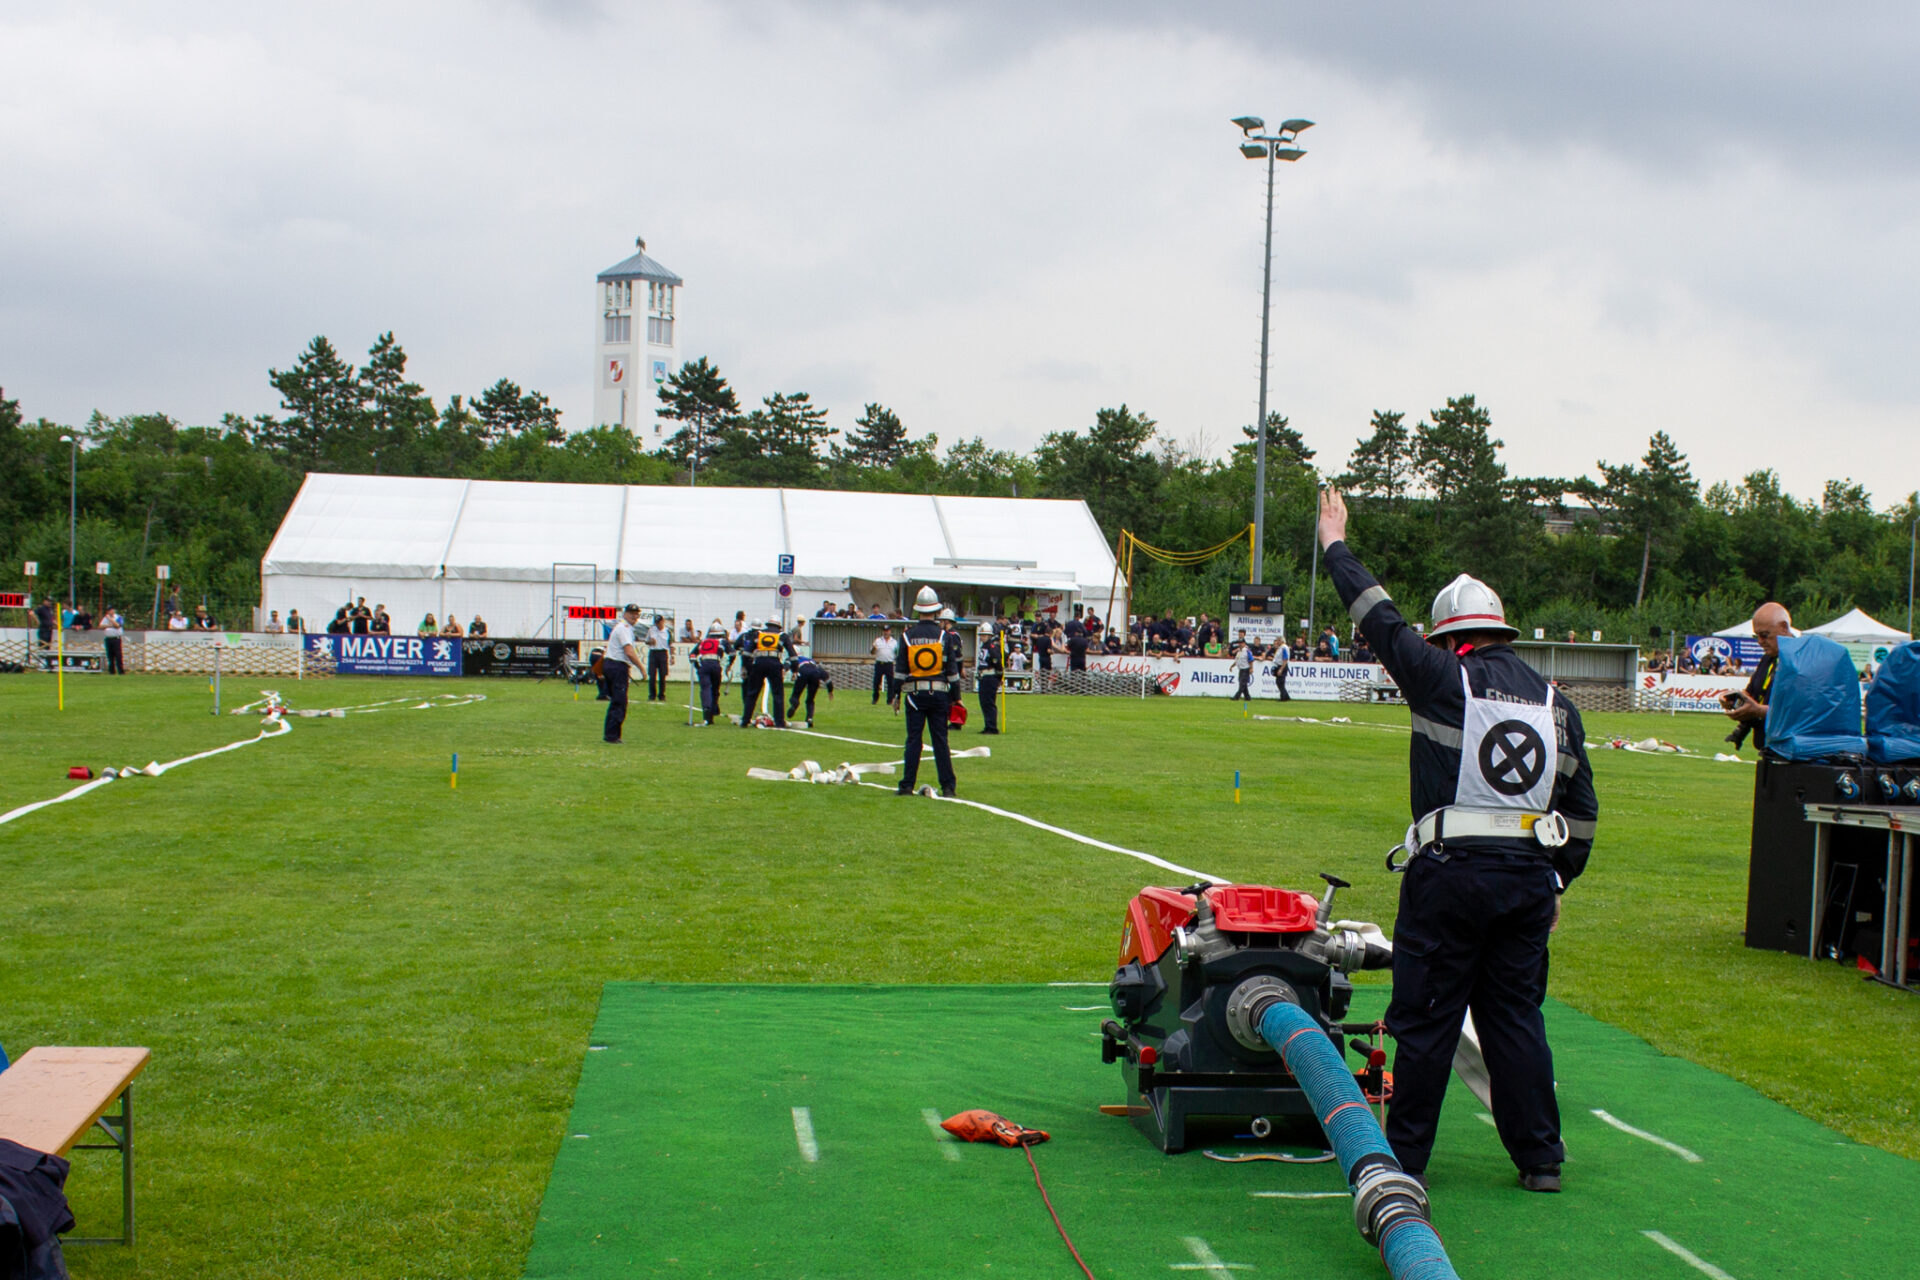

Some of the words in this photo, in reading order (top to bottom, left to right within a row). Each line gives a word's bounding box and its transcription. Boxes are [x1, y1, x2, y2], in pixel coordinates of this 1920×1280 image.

[780, 556, 792, 572] P
[1237, 616, 1263, 624] Allianz
[341, 637, 424, 659] MAYER
[1191, 671, 1235, 684] Allianz
[1320, 667, 1370, 679] HILDNER
[1660, 687, 1729, 702] mayer
